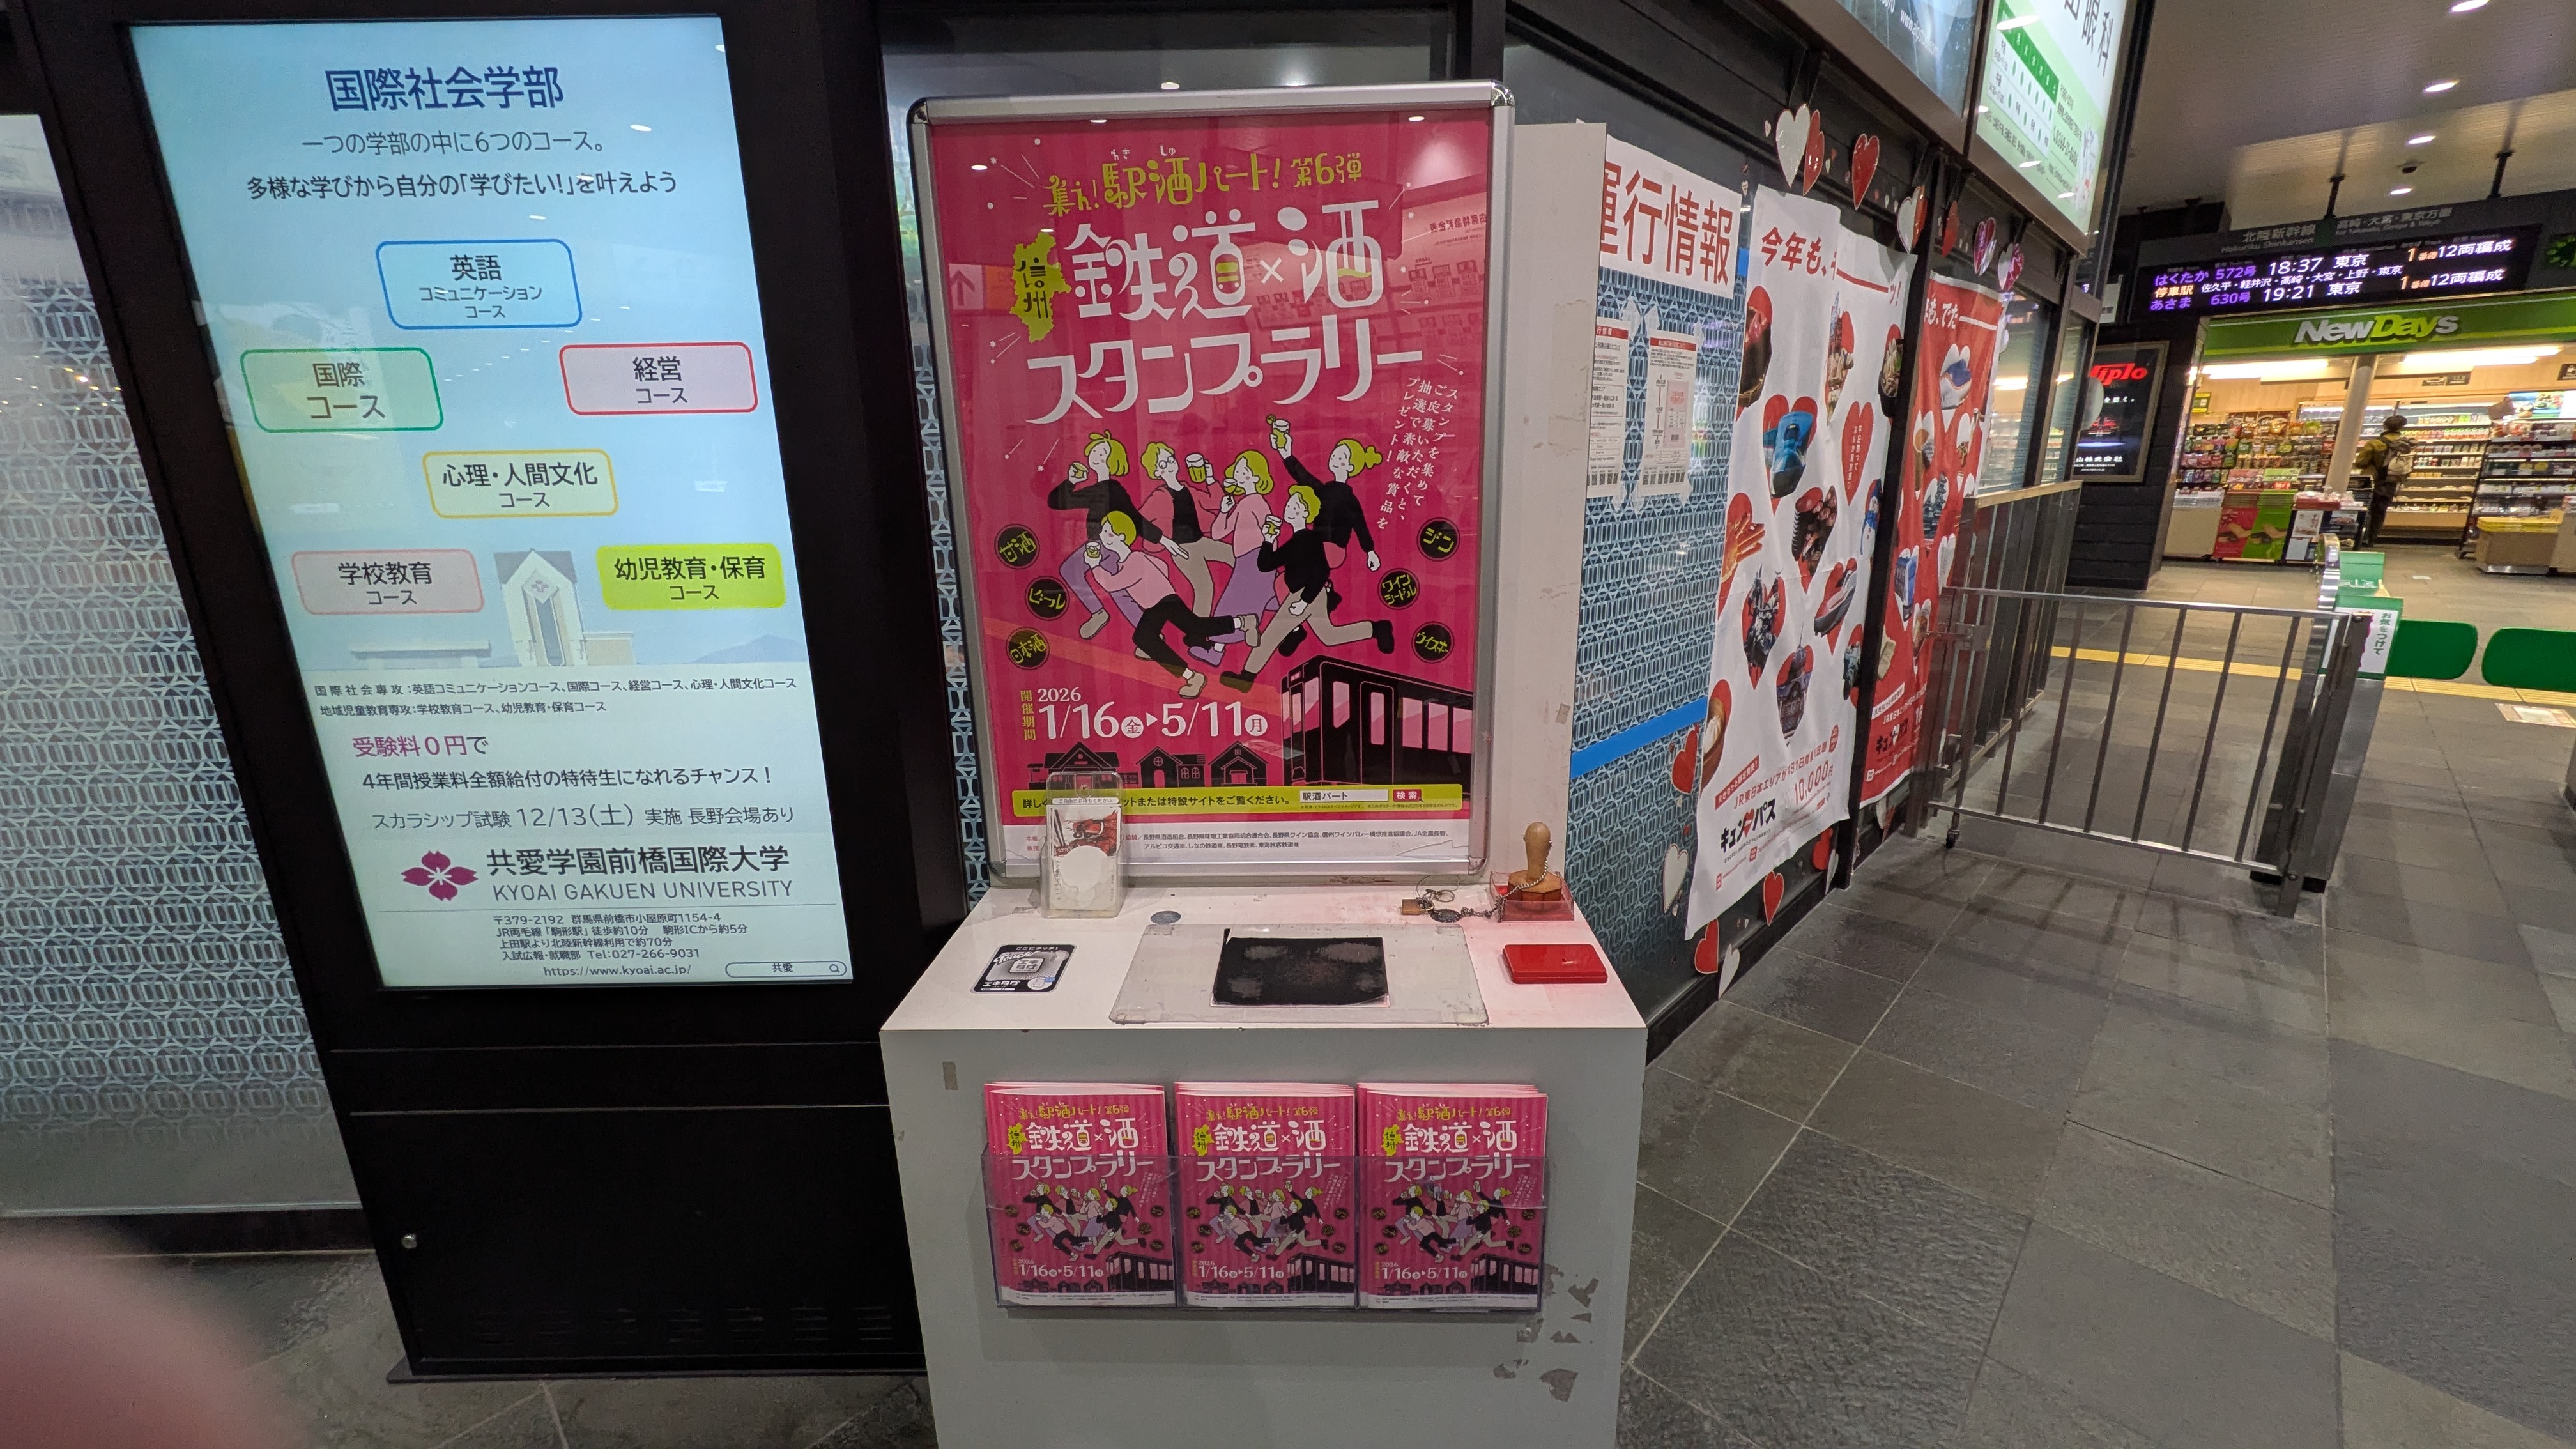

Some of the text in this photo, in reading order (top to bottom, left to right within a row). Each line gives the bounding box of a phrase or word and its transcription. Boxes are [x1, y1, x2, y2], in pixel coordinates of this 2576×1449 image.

[325, 66, 564, 112] 国際社会学部
[302, 130, 604, 156] 一つの学部の中に6つのコース。
[1160, 145, 1177, 156] しゅ
[247, 172, 677, 201] 多様な学びから自分の「学びたい!」を叶えよう
[2242, 224, 2316, 243] 北陸新幹線
[451, 255, 502, 280] 英語
[2155, 270, 2209, 286] はくたか
[2215, 266, 2257, 280] 572号
[2269, 257, 2324, 276] 18:37
[2334, 253, 2370, 268] 東京
[419, 284, 543, 301] コミュニケーション
[1016, 257, 1048, 319] 信州
[2150, 296, 2191, 311] あさま
[2211, 291, 2251, 306] 630号
[2263, 284, 2315, 303] 19:21
[2326, 281, 2363, 296] 東京
[2155, 284, 2194, 298] 停車駅
[465, 304, 506, 319] コース
[2294, 314, 2458, 344] NewDays
[313, 362, 364, 387] 国際
[632, 356, 681, 381] 経営
[1026, 315, 1423, 425] スタンプラリー
[307, 396, 385, 419] コース
[636, 388, 688, 404] コース
[1386, 377, 1421, 462] プレゼント!
[1377, 379, 1432, 530] 抽選で素敵な賞品を
[1413, 388, 1458, 506] スタンプを集めて
[443, 464, 598, 486] 心理・人間文化
[500, 492, 550, 508] コース
[999, 531, 1036, 562] 甘酒
[1423, 528, 1454, 553] ジン
[339, 562, 433, 585] 学校教育
[615, 556, 765, 581] 幼児教育・保育
[670, 585, 719, 600] コース
[1382, 574, 1411, 592] ワイン
[1384, 585, 1417, 604] シードル
[367, 590, 417, 605] コース
[1029, 587, 1065, 609] ビール
[2373, 613, 2392, 656] お気をつけて
[1010, 633, 1046, 664] 日本酒
[1037, 687, 1081, 702] 2026
[1020, 690, 1036, 740] 開催期間
[363, 767, 773, 790] 4年間授業料全額給付の特待生になれるチャンス!
[1302, 791, 1418, 801] 駅酒パート 検索
[372, 802, 795, 829] スカラシップ試験 12/13(土) 実施 長野会場あり
[486, 845, 789, 877] 共愛学園前橋国際大学
[493, 880, 793, 901] KYOAI GAKUEN UNIVERSITY
[494, 911, 722, 926] 〒379-2192 群馬県前橋市小屋原町1154-4
[663, 923, 748, 936] 駒形ICから約5分
[499, 937, 673, 949] 上田駅より北陸新幹線利用で約70分
[502, 949, 581, 962] 入試広報・就職部
[543, 963, 691, 977] https://www.kyoai.ac.jp/
[772, 962, 793, 974] 共愛
[1012, 1150, 1154, 1181] スタンプラリー
[1196, 1151, 1340, 1181] スタンプラリー
[1384, 1152, 1531, 1182] スタンプラリー
